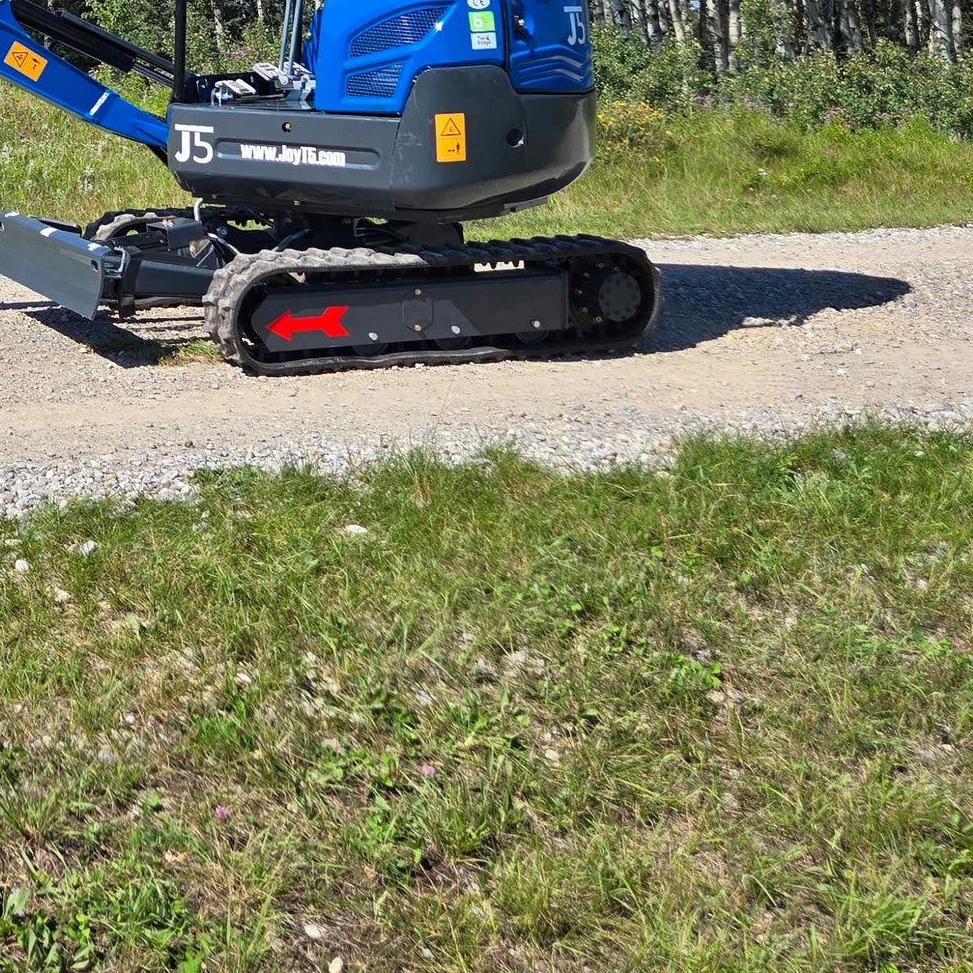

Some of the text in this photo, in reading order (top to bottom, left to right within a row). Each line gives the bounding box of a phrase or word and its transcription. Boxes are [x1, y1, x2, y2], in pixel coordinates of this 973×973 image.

[563, 6, 586, 45] J5
[174, 124, 214, 164] J5
[240, 144, 346, 167] www.JoyT5.com
